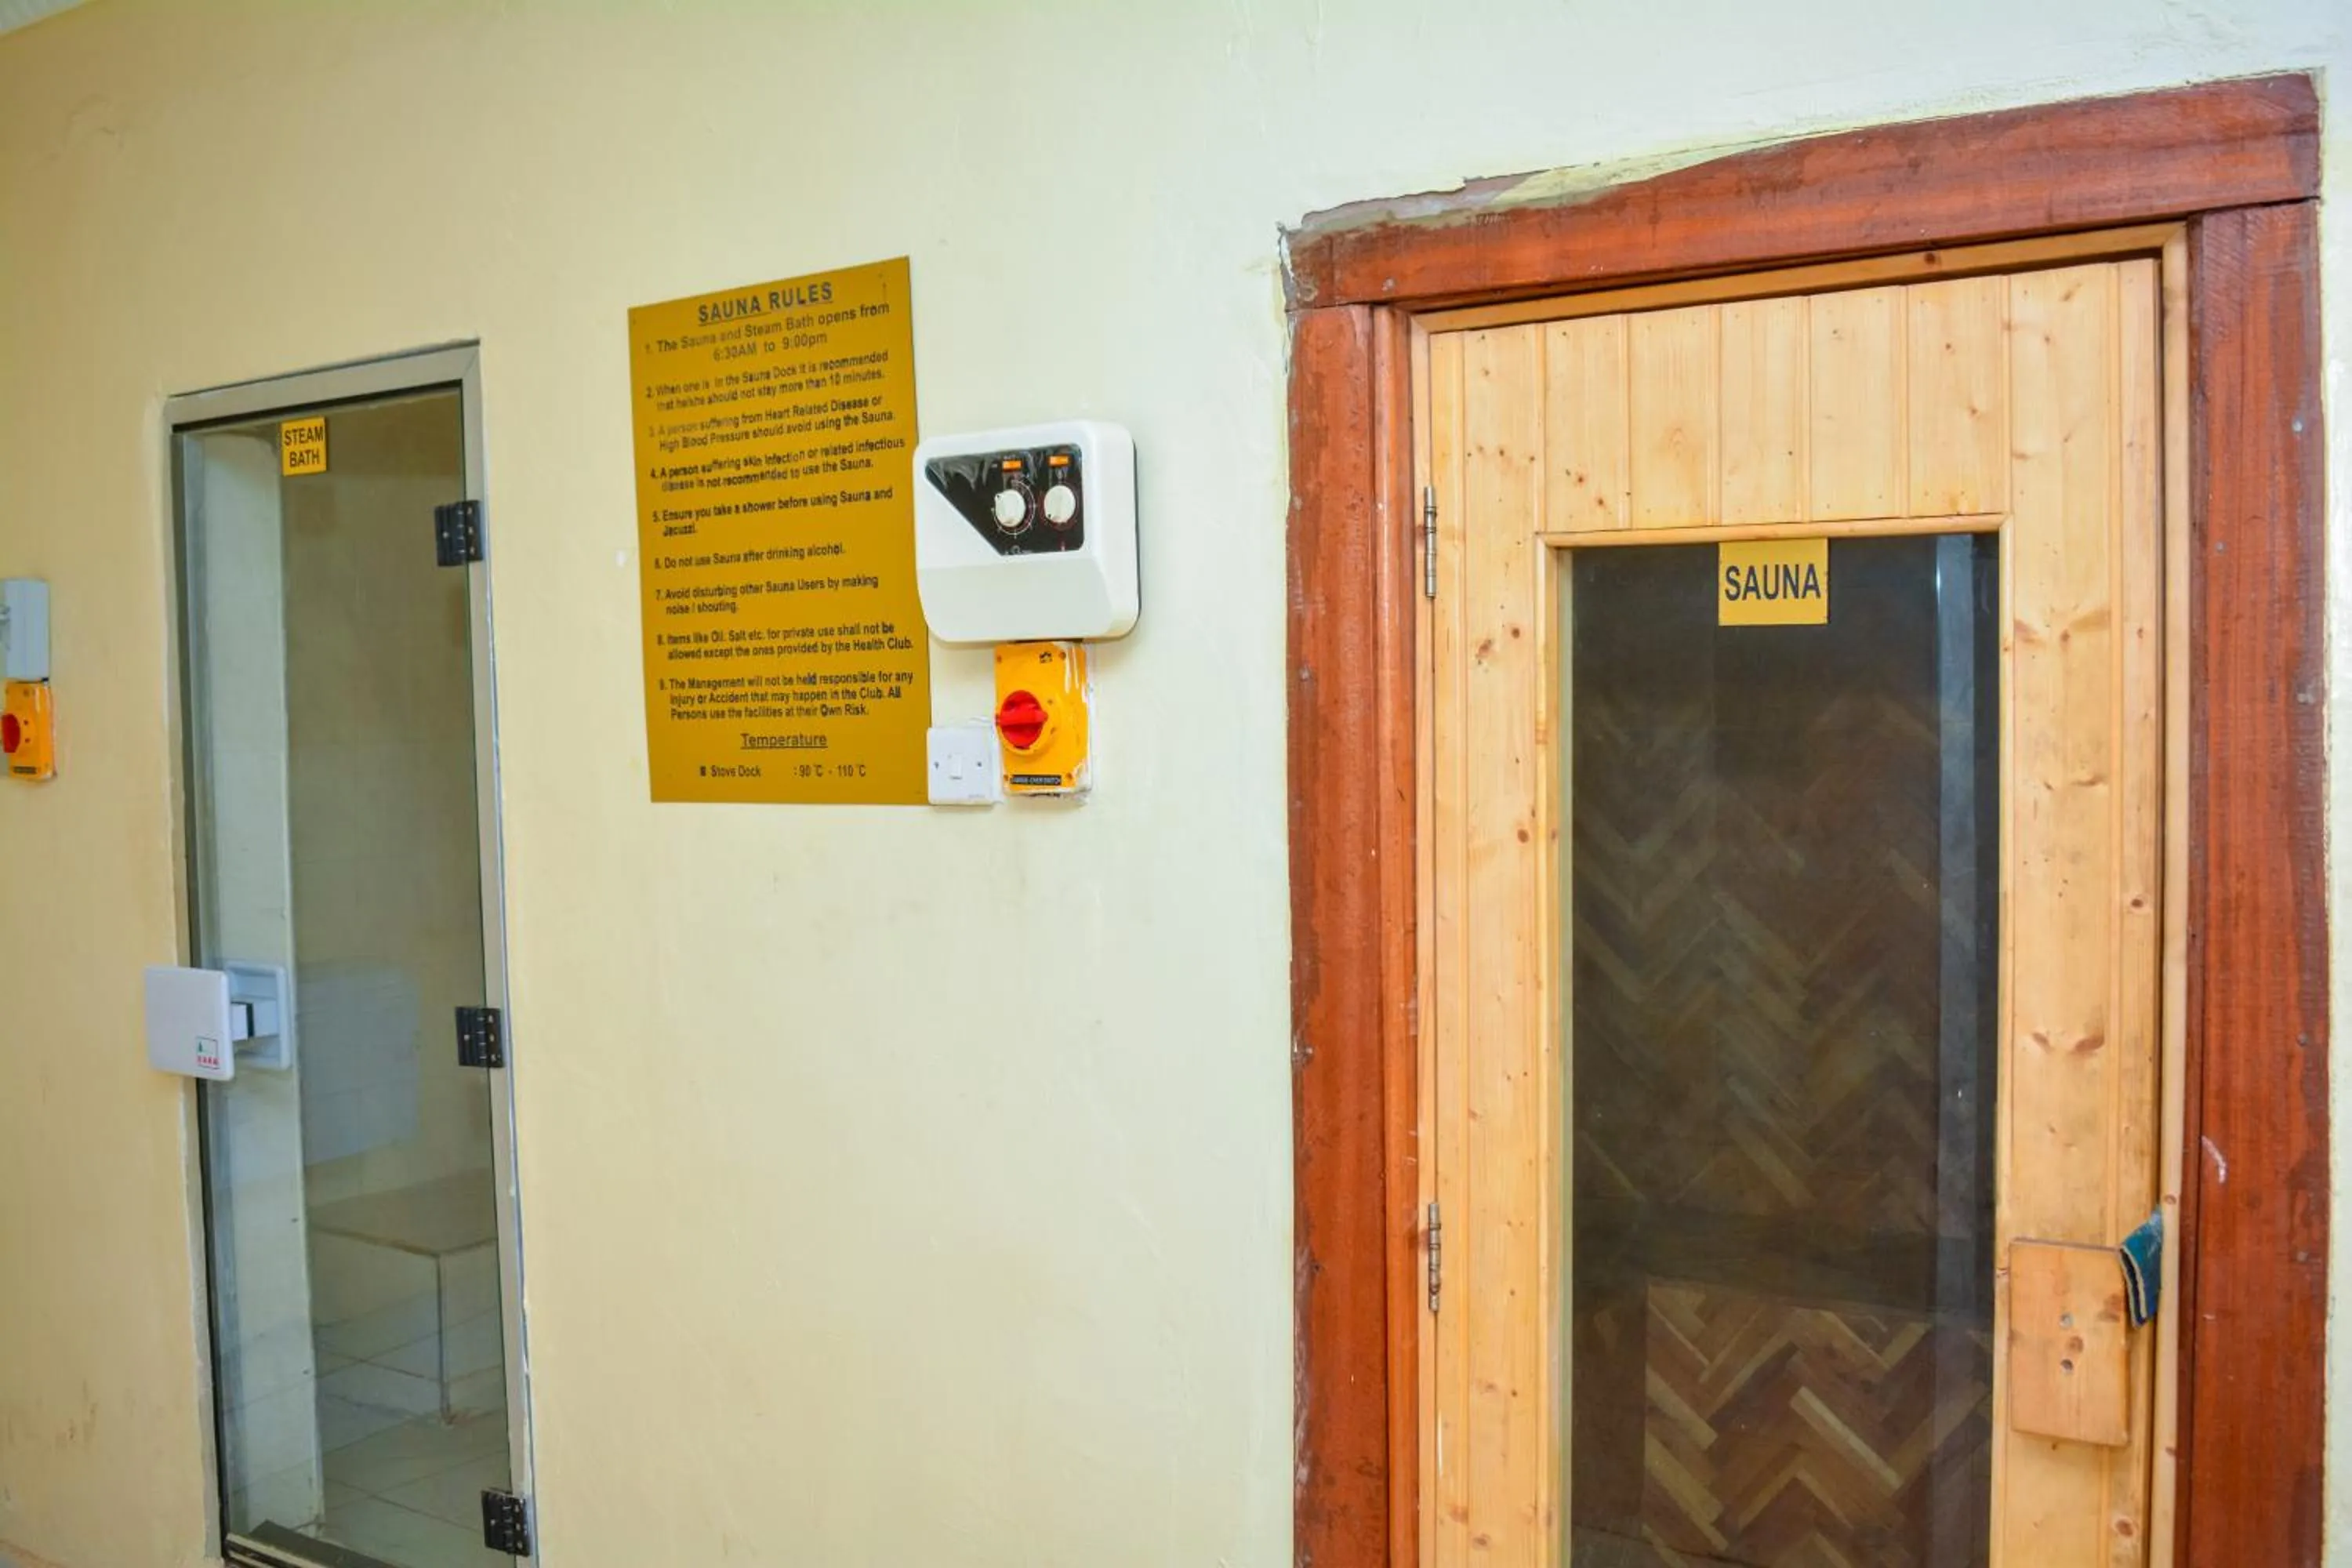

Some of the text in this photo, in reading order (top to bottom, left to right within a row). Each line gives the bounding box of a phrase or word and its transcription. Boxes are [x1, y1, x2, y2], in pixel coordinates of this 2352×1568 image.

[699, 282, 833, 323] SAUNA RULES
[657, 339, 677, 352] The
[680, 336, 716, 350] Sauna
[720, 328, 741, 342] and
[745, 323, 782, 338] Steam
[786, 315, 814, 330] Bath
[818, 309, 856, 326] opens
[859, 302, 890, 318] from
[764, 341, 775, 352] to
[782, 333, 827, 350] 9:00pm
[656, 383, 681, 396] When
[683, 383, 700, 394] one
[702, 380, 710, 390] is
[725, 374, 739, 385] the
[742, 371, 771, 384] Sauna
[808, 362, 816, 372] is
[820, 351, 888, 371] recommended
[707, 391, 738, 405] should
[739, 389, 754, 399] not
[757, 384, 776, 399] stay
[779, 381, 803, 394] more
[805, 377, 826, 389] than
[829, 373, 841, 387] 10
[667, 423, 698, 436] person
[700, 416, 739, 432] suffering
[741, 412, 762, 424] from
[764, 408, 789, 421] Heart
[792, 402, 829, 417] Related
[830, 398, 869, 412] Disease
[871, 396, 882, 406] or
[285, 426, 324, 446] STEAM
[659, 441, 678, 453] High
[681, 436, 708, 448] Blood
[710, 431, 750, 445] Pressure
[752, 425, 783, 438] should
[787, 420, 811, 433] avoid
[815, 416, 841, 430] using
[844, 414, 859, 426] the
[289, 448, 320, 468] BATH
[660, 467, 666, 478] A
[670, 465, 699, 479] person
[701, 459, 741, 474] suffering
[742, 456, 762, 469] skin
[808, 449, 818, 459] or
[820, 443, 854, 457] related
[662, 458, 874, 492] disease is not recommended to use the Sauna.
[652, 511, 661, 523] 5.
[662, 510, 692, 521] Ensure
[695, 508, 711, 521] you
[713, 504, 732, 516] take
[742, 500, 775, 513] shower
[777, 495, 808, 509] before
[810, 492, 837, 508] using
[840, 489, 870, 503] Sauna
[873, 485, 893, 500] and
[664, 557, 677, 568] Do
[679, 554, 692, 567] not
[695, 556, 711, 566] use
[713, 553, 741, 564] Sauna
[742, 550, 764, 563] after
[766, 546, 805, 561] drinking
[807, 542, 846, 557] alcohol.
[666, 588, 691, 599] Avoid
[692, 585, 738, 598] disturbing
[739, 583, 763, 594] other
[765, 581, 794, 593] Sauna
[797, 579, 825, 590] Users
[827, 577, 839, 590] by
[842, 574, 879, 588] making
[1725, 563, 1821, 601] SAUNA
[666, 604, 690, 615] noise
[693, 631, 709, 644] like
[728, 629, 746, 641] Salt
[748, 629, 766, 641] etc.
[767, 627, 780, 640] for
[782, 627, 815, 640] private
[818, 626, 835, 637] use
[837, 622, 861, 637] shall
[863, 623, 879, 634] not
[881, 622, 895, 634] be
[668, 636, 914, 660] allowed except the ones provided by the Health Club.
[670, 678, 686, 689] The
[688, 677, 743, 691] Management
[747, 676, 763, 687] will
[765, 675, 781, 687] not
[782, 675, 794, 686] be
[797, 673, 817, 685] held
[819, 671, 876, 685] responsible
[879, 671, 892, 683] for
[895, 672, 913, 684] any
[697, 695, 708, 705] or
[710, 691, 748, 704] Accident
[750, 691, 769, 703] that
[771, 692, 790, 704] may
[793, 690, 828, 703] happen
[830, 689, 840, 700] in
[841, 688, 857, 700] the
[888, 685, 901, 698] All
[670, 703, 869, 720] Persons use the facilities at their Own Risk.
[740, 733, 828, 750] Temperature
[711, 765, 736, 778] Stove
[738, 765, 761, 778] Dock
[837, 765, 853, 777] 110
